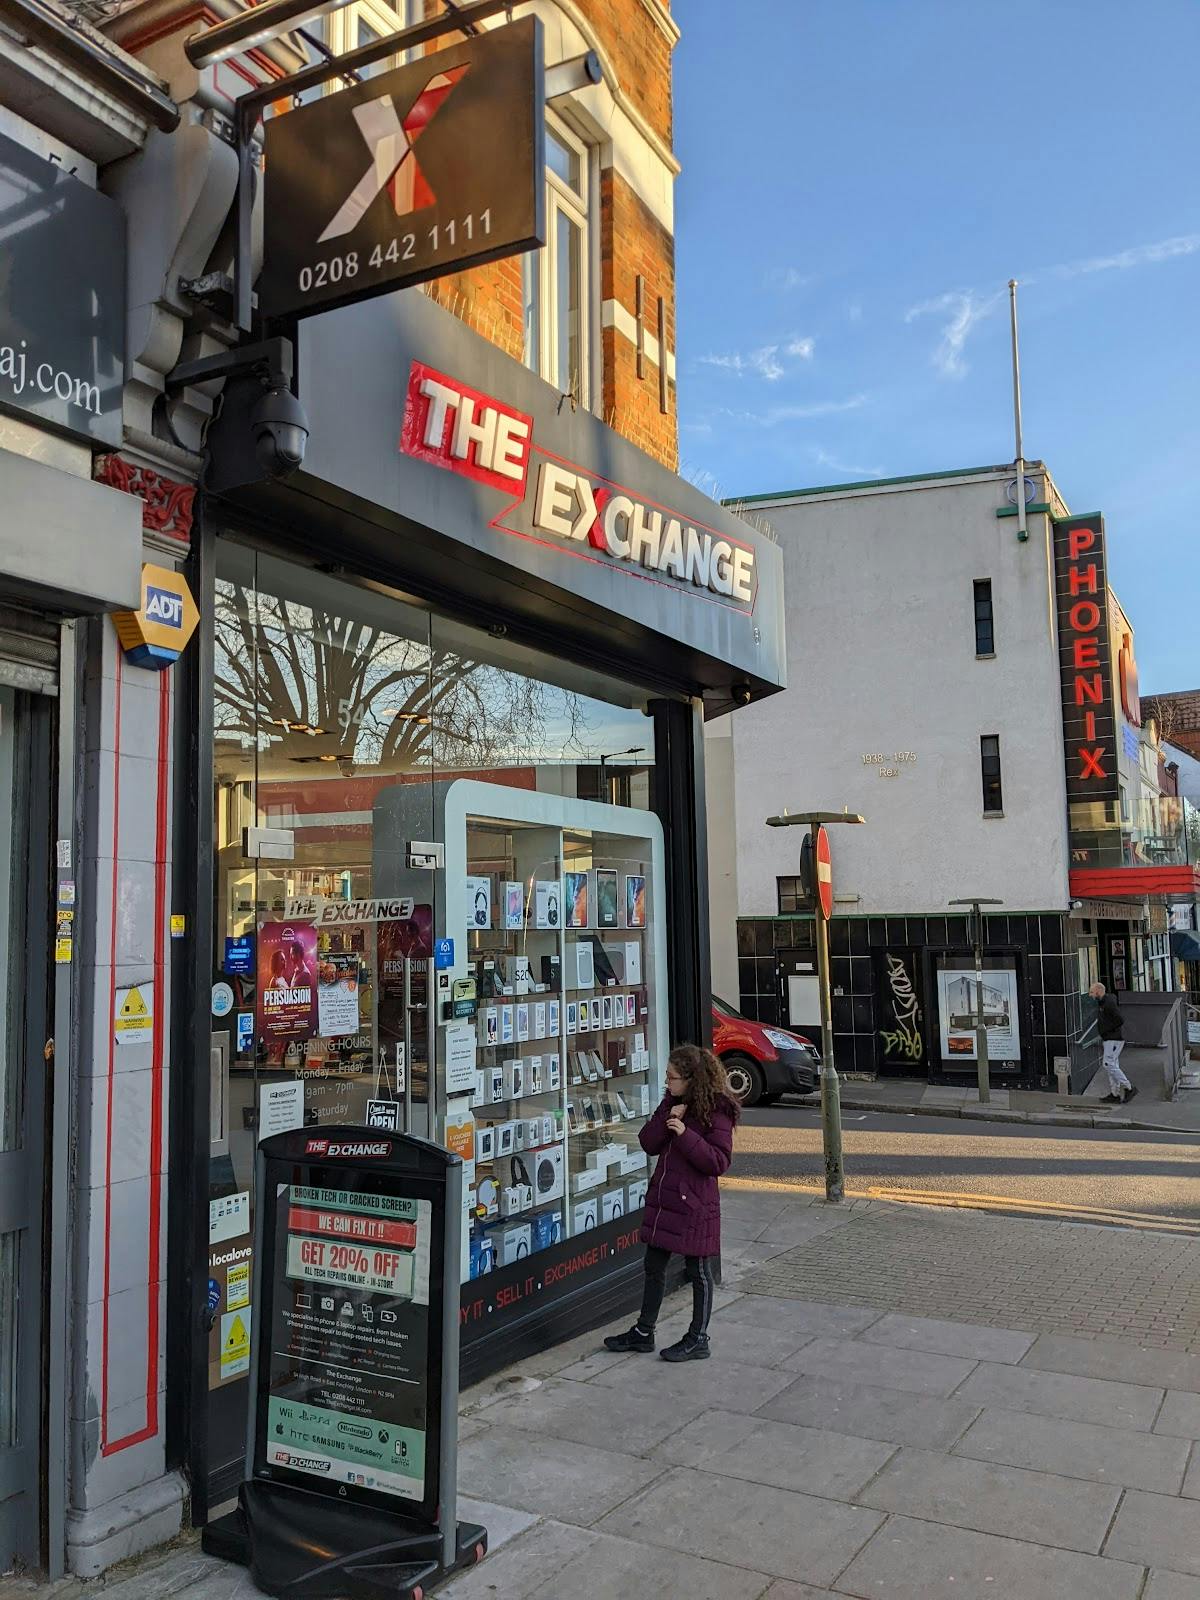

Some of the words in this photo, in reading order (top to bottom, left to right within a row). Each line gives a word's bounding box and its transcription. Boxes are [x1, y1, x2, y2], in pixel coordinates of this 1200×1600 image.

[299, 252, 359, 292] 0208
[368, 233, 416, 269] 442
[428, 208, 491, 250] 1111
[0, 340, 103, 415] aj.com
[419, 378, 530, 481] THE
[532, 462, 755, 602] EXCHANGE
[146, 592, 183, 622] ADT
[1069, 527, 1108, 779] PHOENIX
[337, 699, 365, 728] 54
[862, 753, 884, 764] 1938
[894, 751, 917, 763] 1975
[880, 767, 898, 777] Rex
[289, 899, 317, 916] THE
[322, 900, 410, 922] EXCHANGE
[264, 989, 311, 1006] PERSUASION
[288, 1040, 335, 1057] OPENING
[338, 1036, 372, 1049] HOURS
[295, 1067, 329, 1080] Monday
[338, 1062, 364, 1074] Friday
[306, 1086, 326, 1099] 9am
[335, 1081, 354, 1095] 7pm
[311, 1103, 349, 1119] Saturday
[370, 1115, 395, 1129] OPEN
[308, 1141, 327, 1151] THE
[327, 1143, 389, 1155] EXCHANGE
[294, 1187, 319, 1201] BROKEN
[321, 1190, 337, 1202] TECH
[339, 1192, 348, 1204] OR
[349, 1194, 380, 1208] CRACKED
[381, 1197, 412, 1213] SCREEN?
[318, 1214, 332, 1230] WE
[333, 1216, 351, 1233] CAN
[353, 1219, 366, 1236] FIX
[368, 1221, 376, 1236] IT
[212, 1247, 252, 1267] localove
[301, 1240, 326, 1266] GET
[329, 1245, 369, 1274] 20%
[373, 1251, 400, 1278] OFF
[304, 1266, 313, 1276] ALL
[314, 1268, 326, 1278] TECH
[347, 1273, 365, 1285] ONLINE
[473, 1299, 484, 1321] IT
[496, 1283, 522, 1309] SELL
[525, 1276, 536, 1296] IT
[543, 1248, 599, 1287] EXCHANGE
[600, 1242, 609, 1260] IT
[616, 1233, 631, 1253] FIX
[326, 1369, 336, 1378] The
[336, 1371, 362, 1383] Exchange
[279, 1406, 293, 1419] Wii
[340, 1423, 371, 1438] Nintendo
[312, 1434, 346, 1450] SAMSUNG
[276, 1452, 290, 1461] THE
[289, 1457, 330, 1471] EXCHANGE
